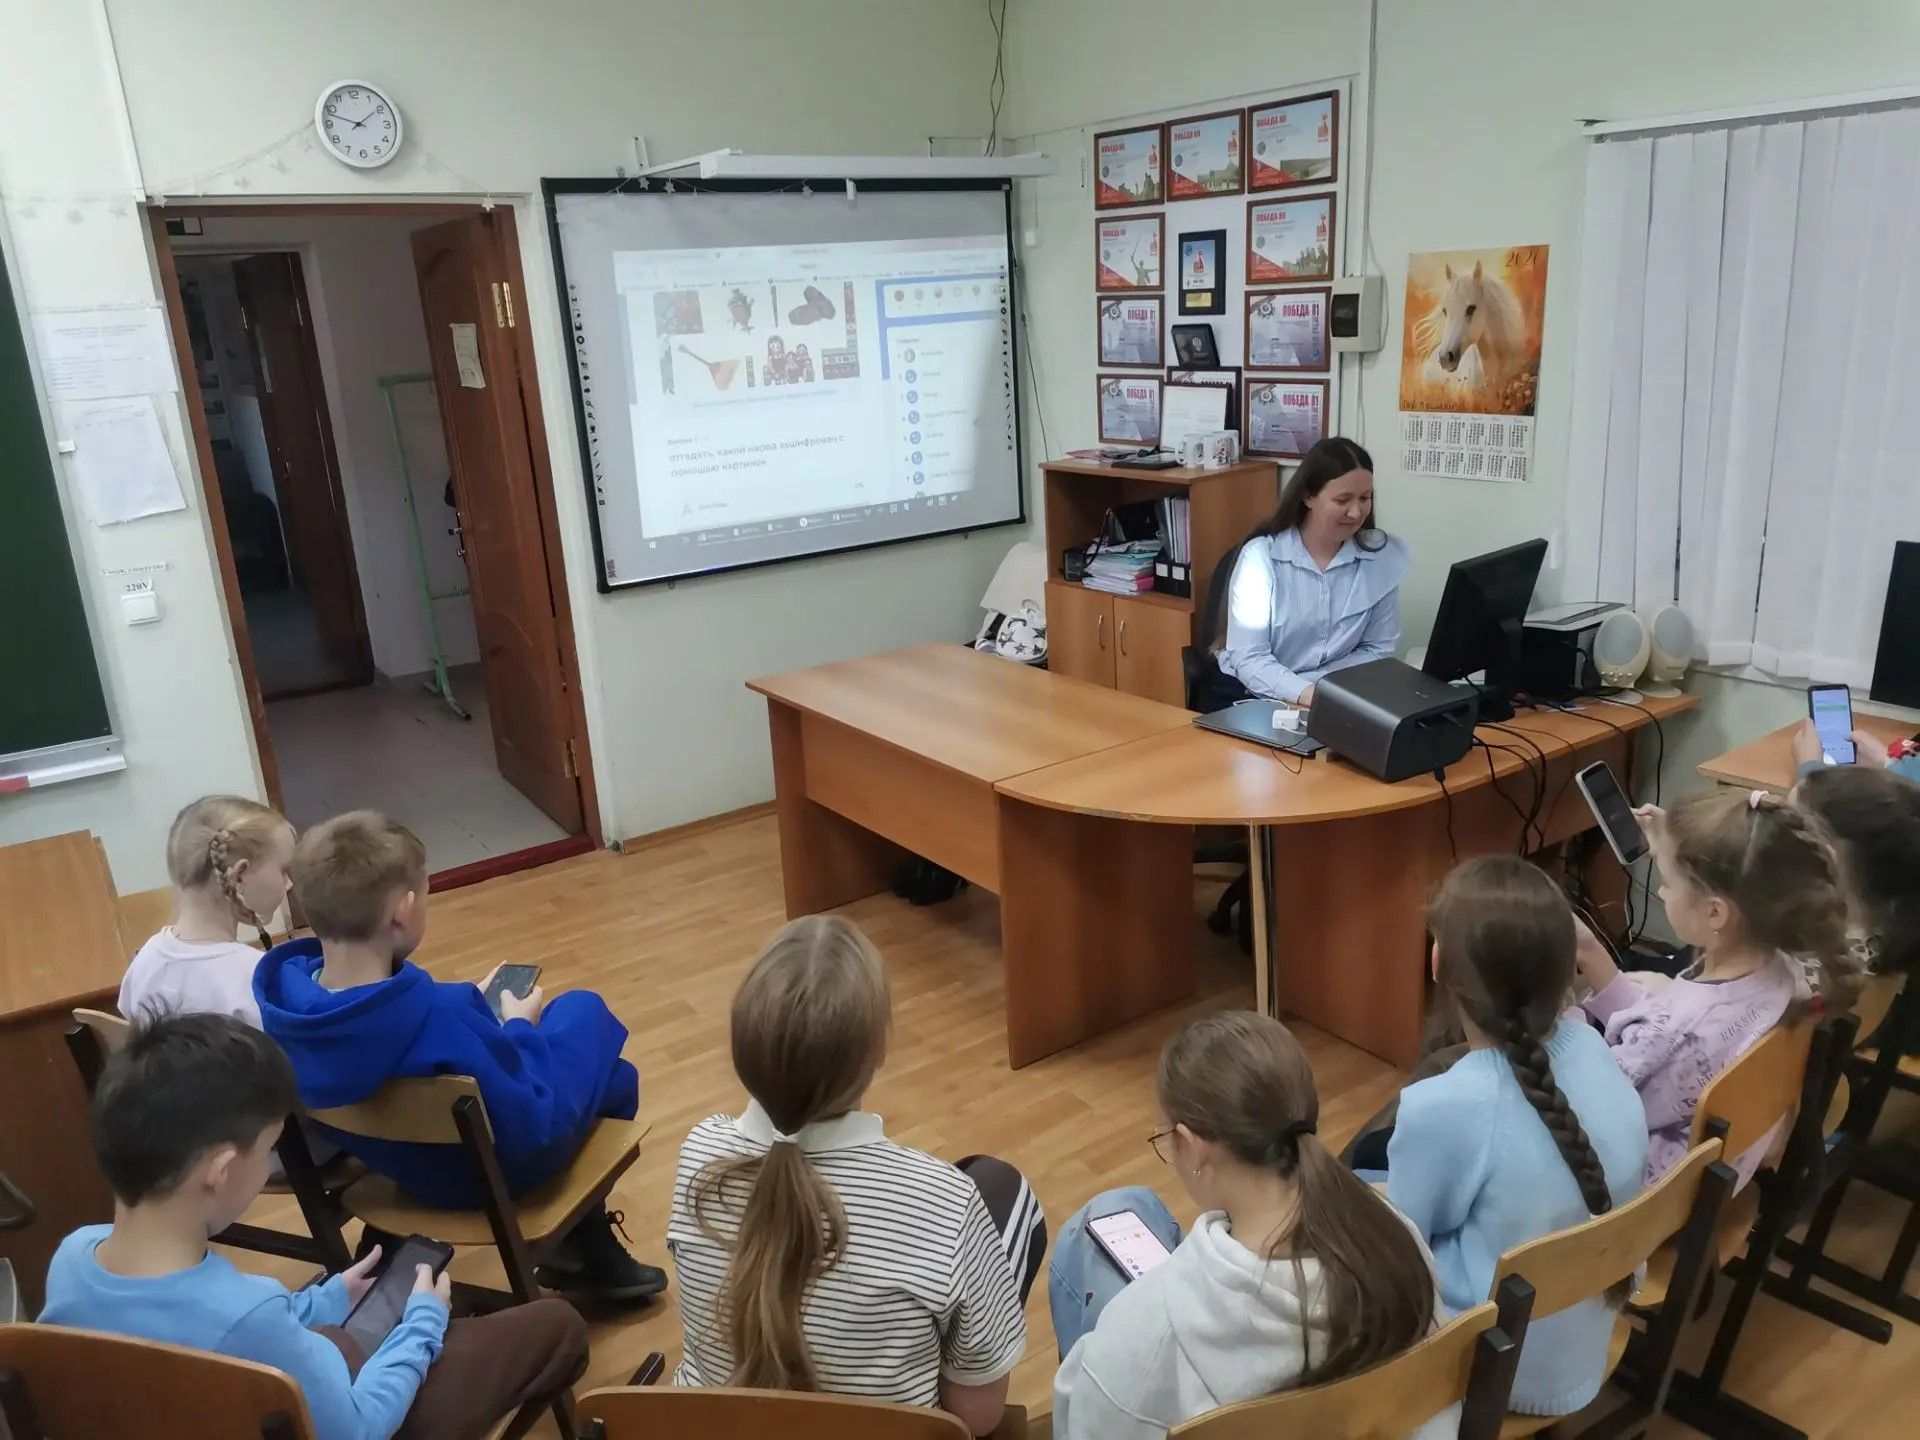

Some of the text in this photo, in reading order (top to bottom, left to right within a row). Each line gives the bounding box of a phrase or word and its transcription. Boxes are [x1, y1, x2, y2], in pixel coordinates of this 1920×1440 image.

[348, 90, 359, 99] 12
[376, 105, 384, 114] 2
[326, 120, 333, 129] 9
[383, 120, 391, 129] 3
[333, 135, 340, 144] 8
[382, 135, 389, 143] 4
[345, 146, 351, 154] 7
[374, 145, 381, 154] 5
[360, 150, 368, 159] 6
[1282, 304, 1309, 317] ПОБЕДА
[1282, 394, 1309, 407] ПОБЕДА
